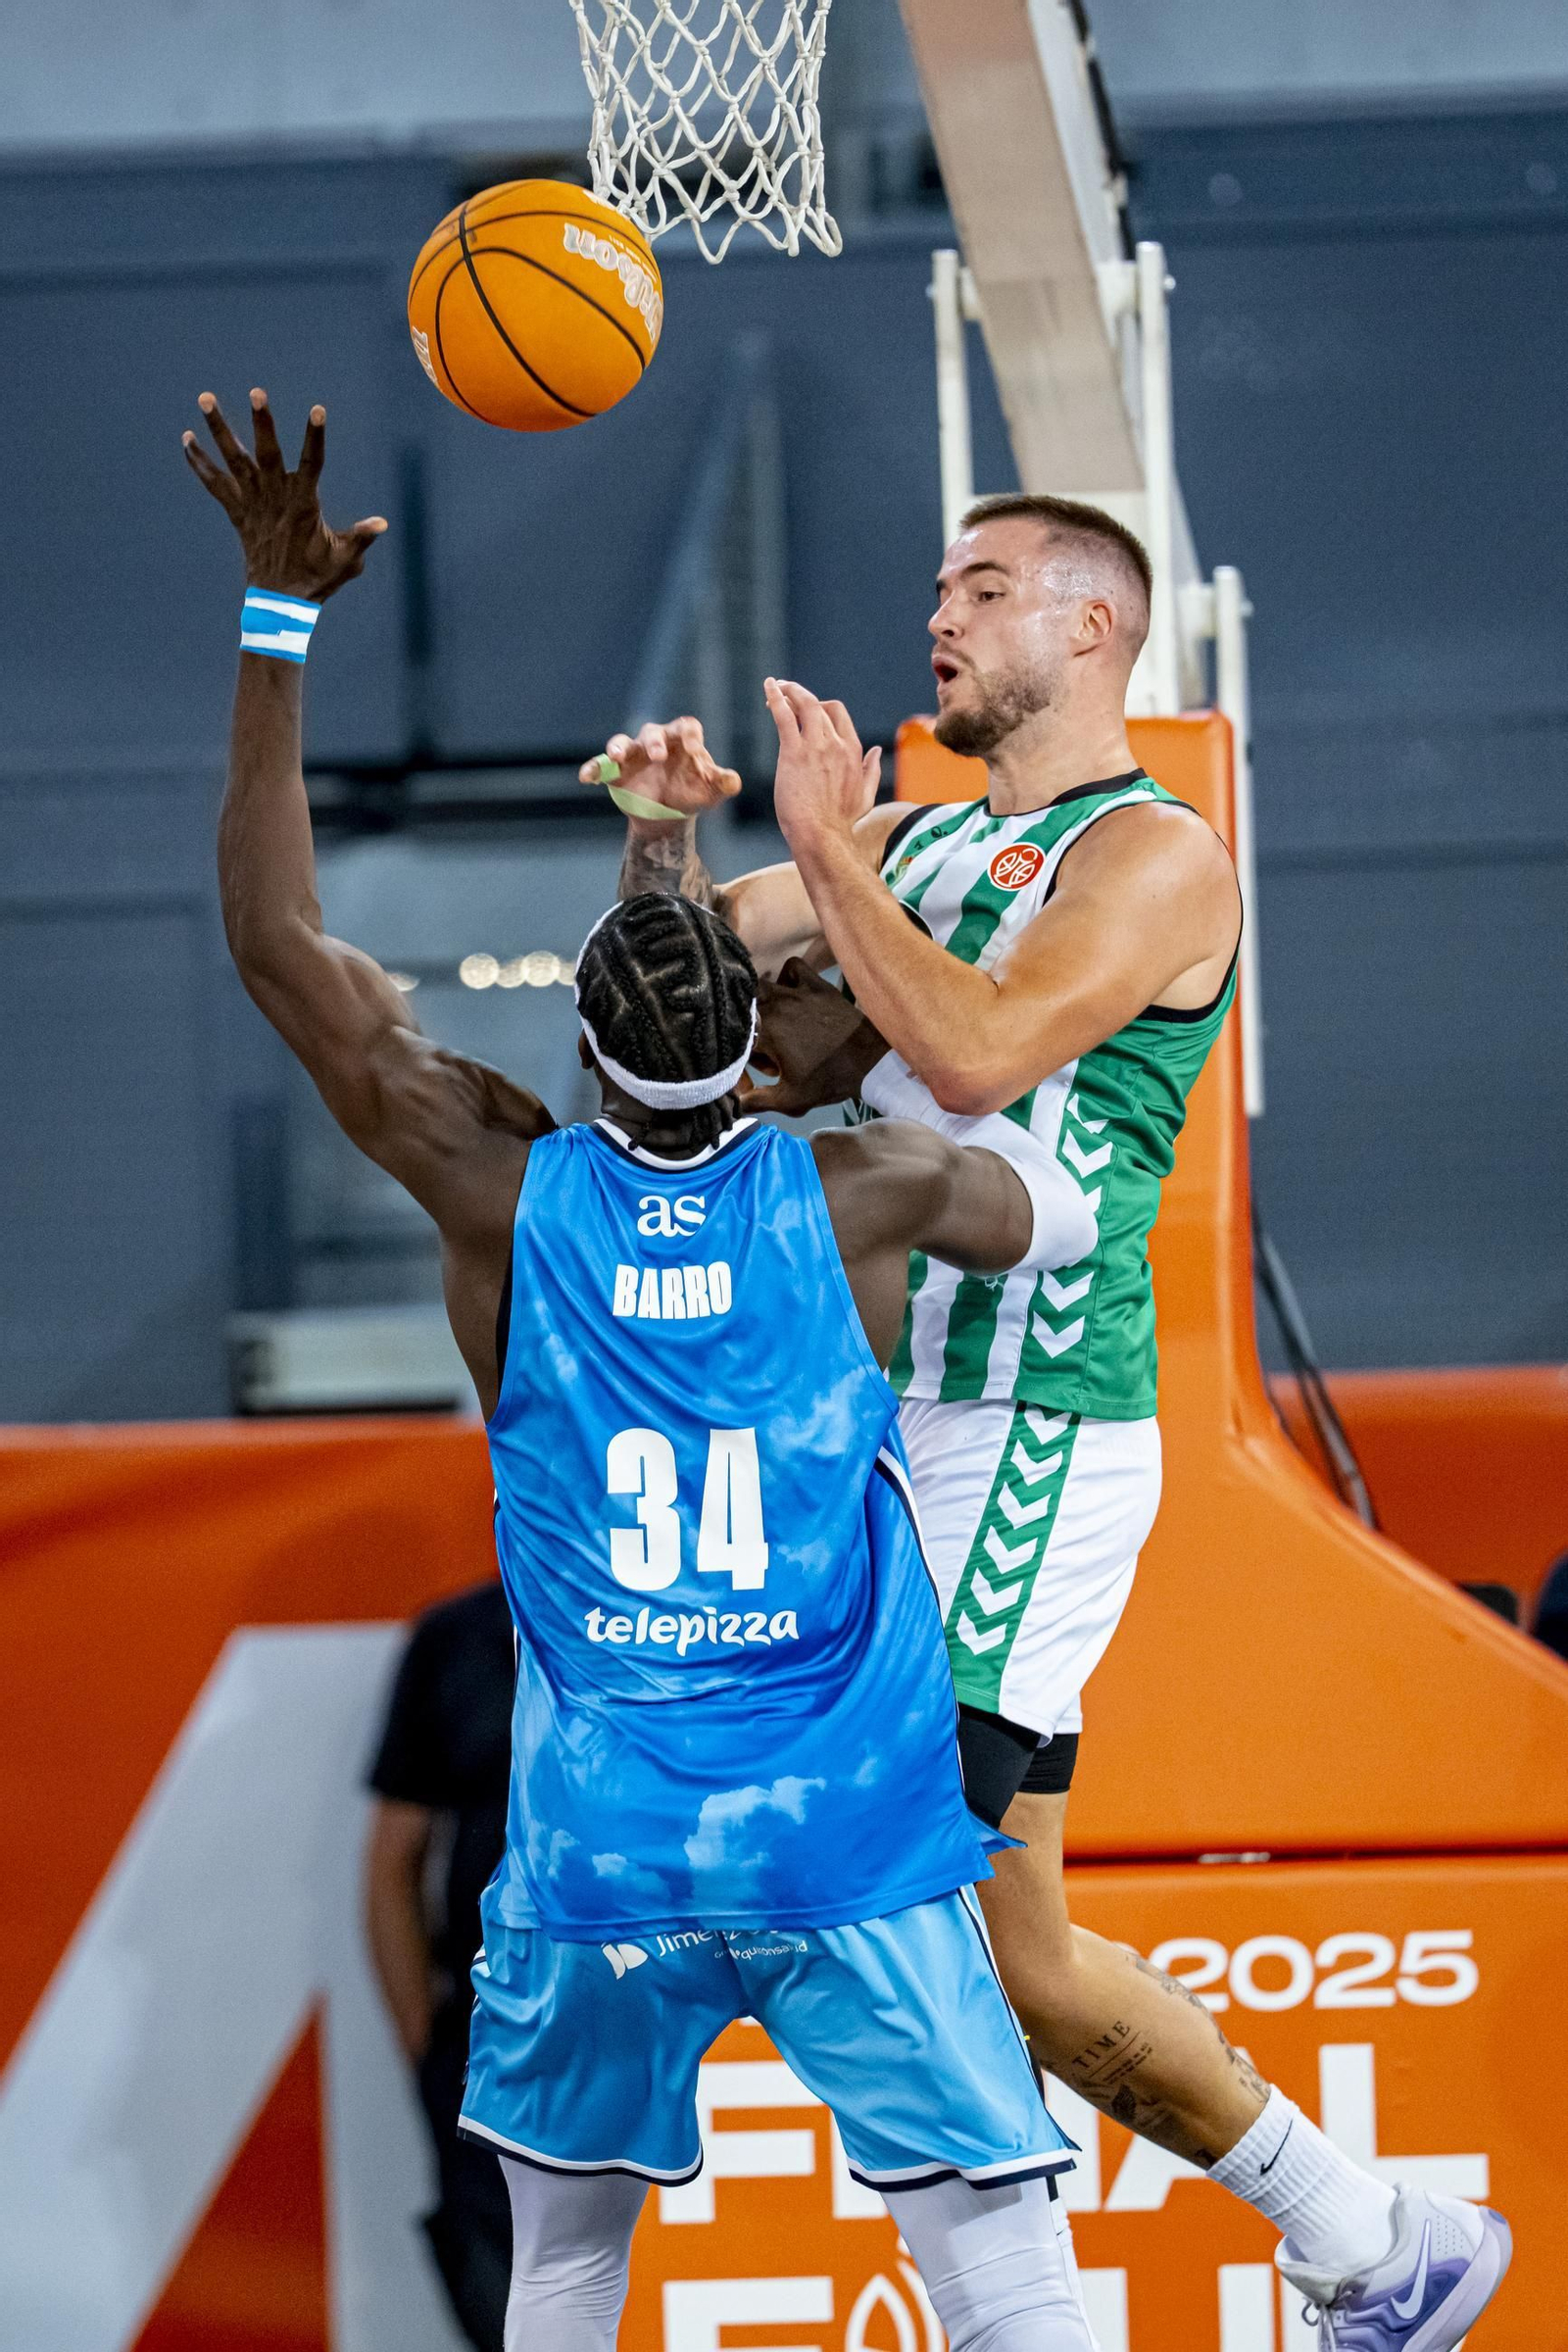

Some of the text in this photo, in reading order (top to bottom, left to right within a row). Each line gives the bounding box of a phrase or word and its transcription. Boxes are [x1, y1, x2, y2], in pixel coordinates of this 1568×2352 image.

[637, 1195, 707, 1238] as
[612, 1261, 733, 1320] BARRO
[607, 1427, 768, 1592] 34
[584, 1605, 800, 1657] telepizza
[656, 1930, 742, 1957] Jime
[1148, 1929, 1479, 2012] 2025
[1071, 2021, 1131, 2070] TIME
